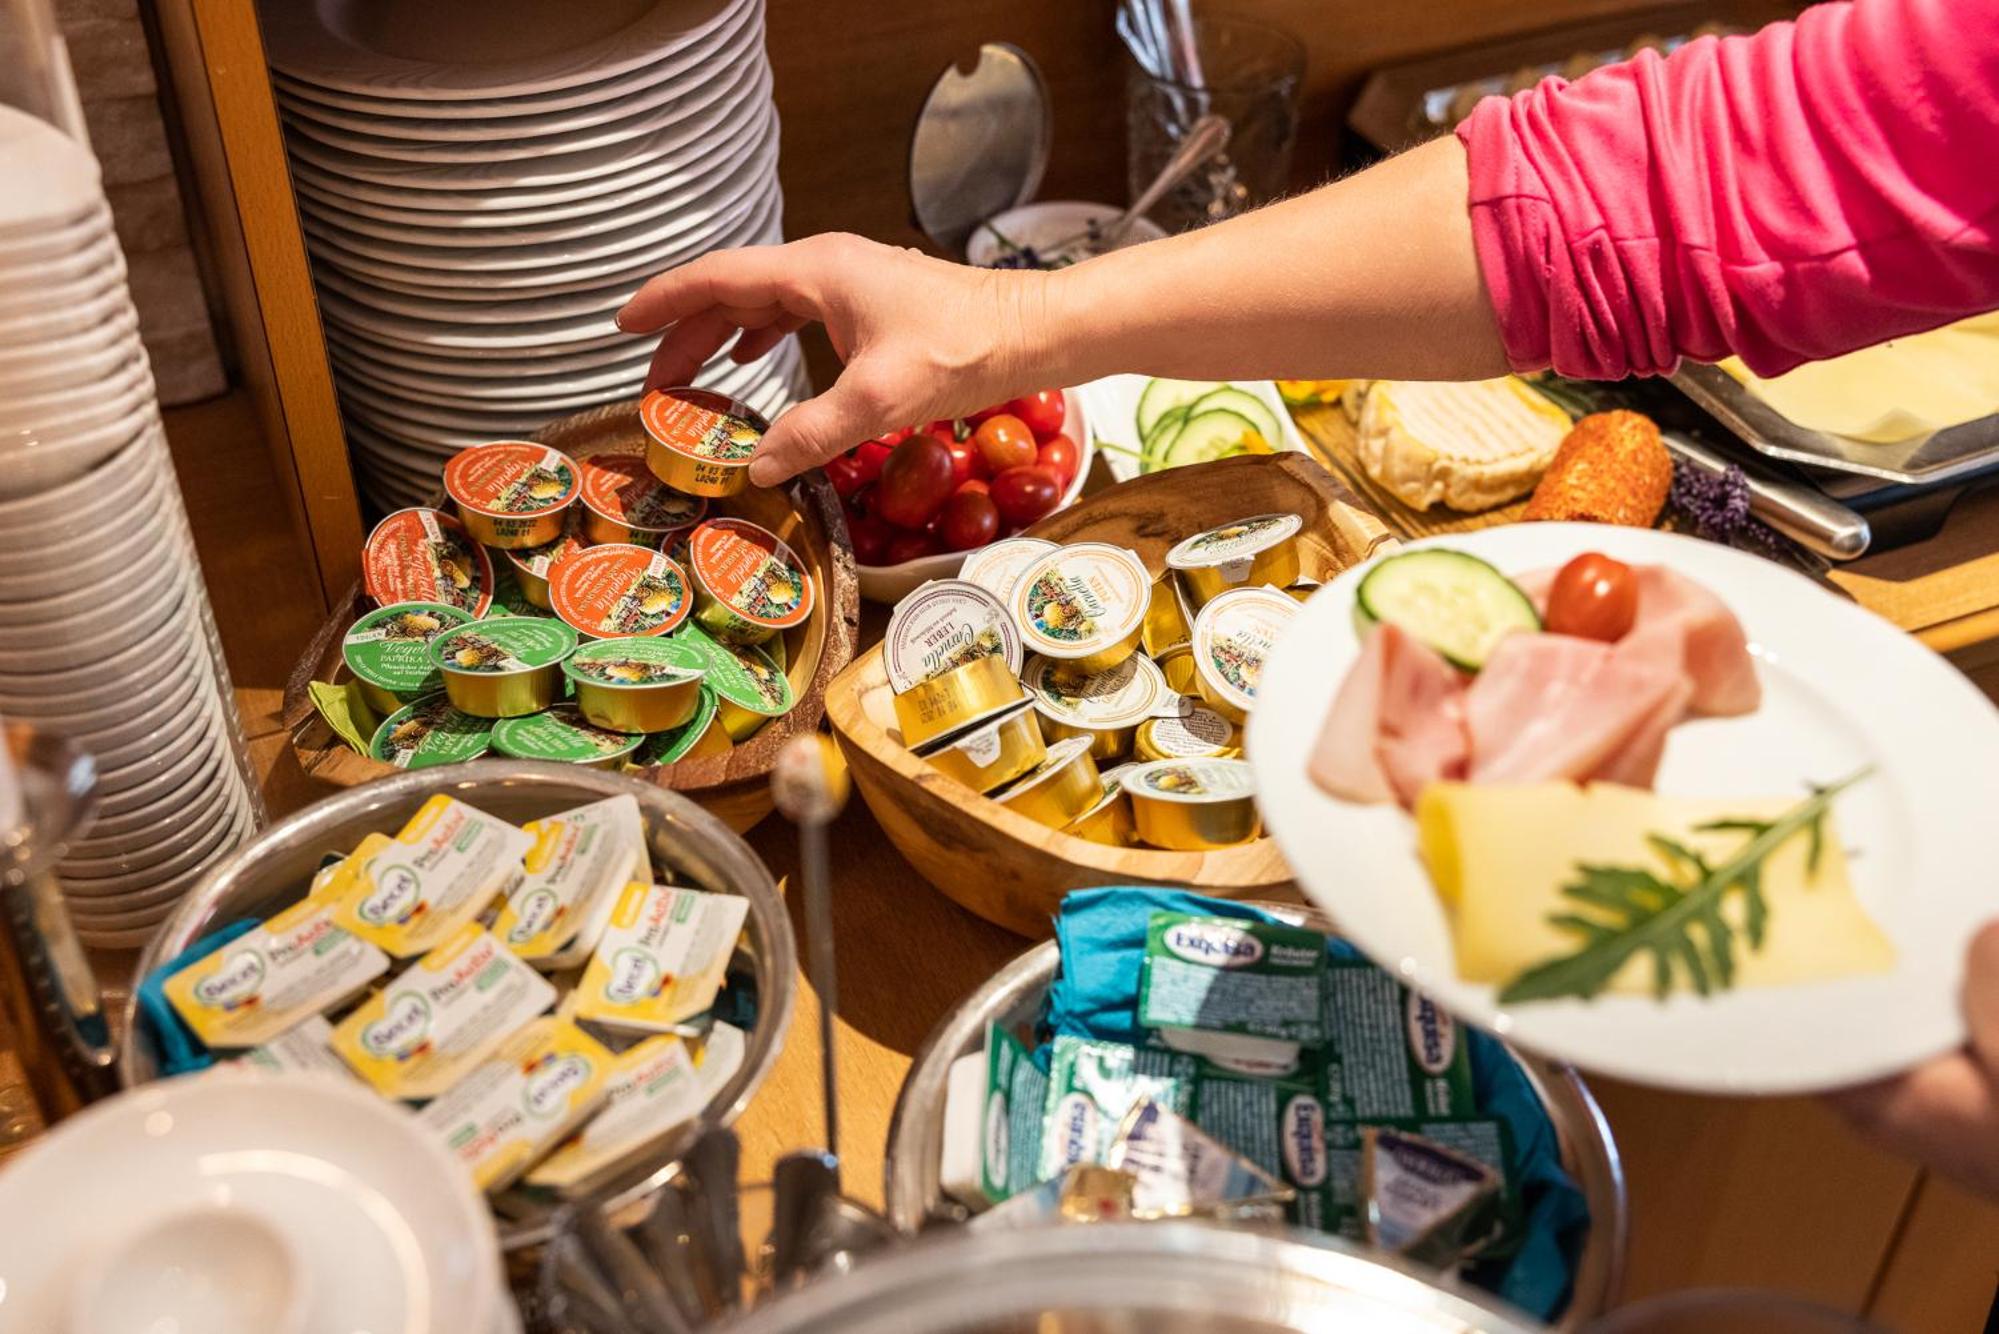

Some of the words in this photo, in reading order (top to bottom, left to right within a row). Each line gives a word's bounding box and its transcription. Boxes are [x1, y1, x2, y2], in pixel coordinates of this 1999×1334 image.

[409, 538, 438, 601] Vegetell
[922, 622, 974, 671] Carnella
[924, 621, 955, 648] LEBER
[1291, 1103, 1316, 1178] Exquisa
